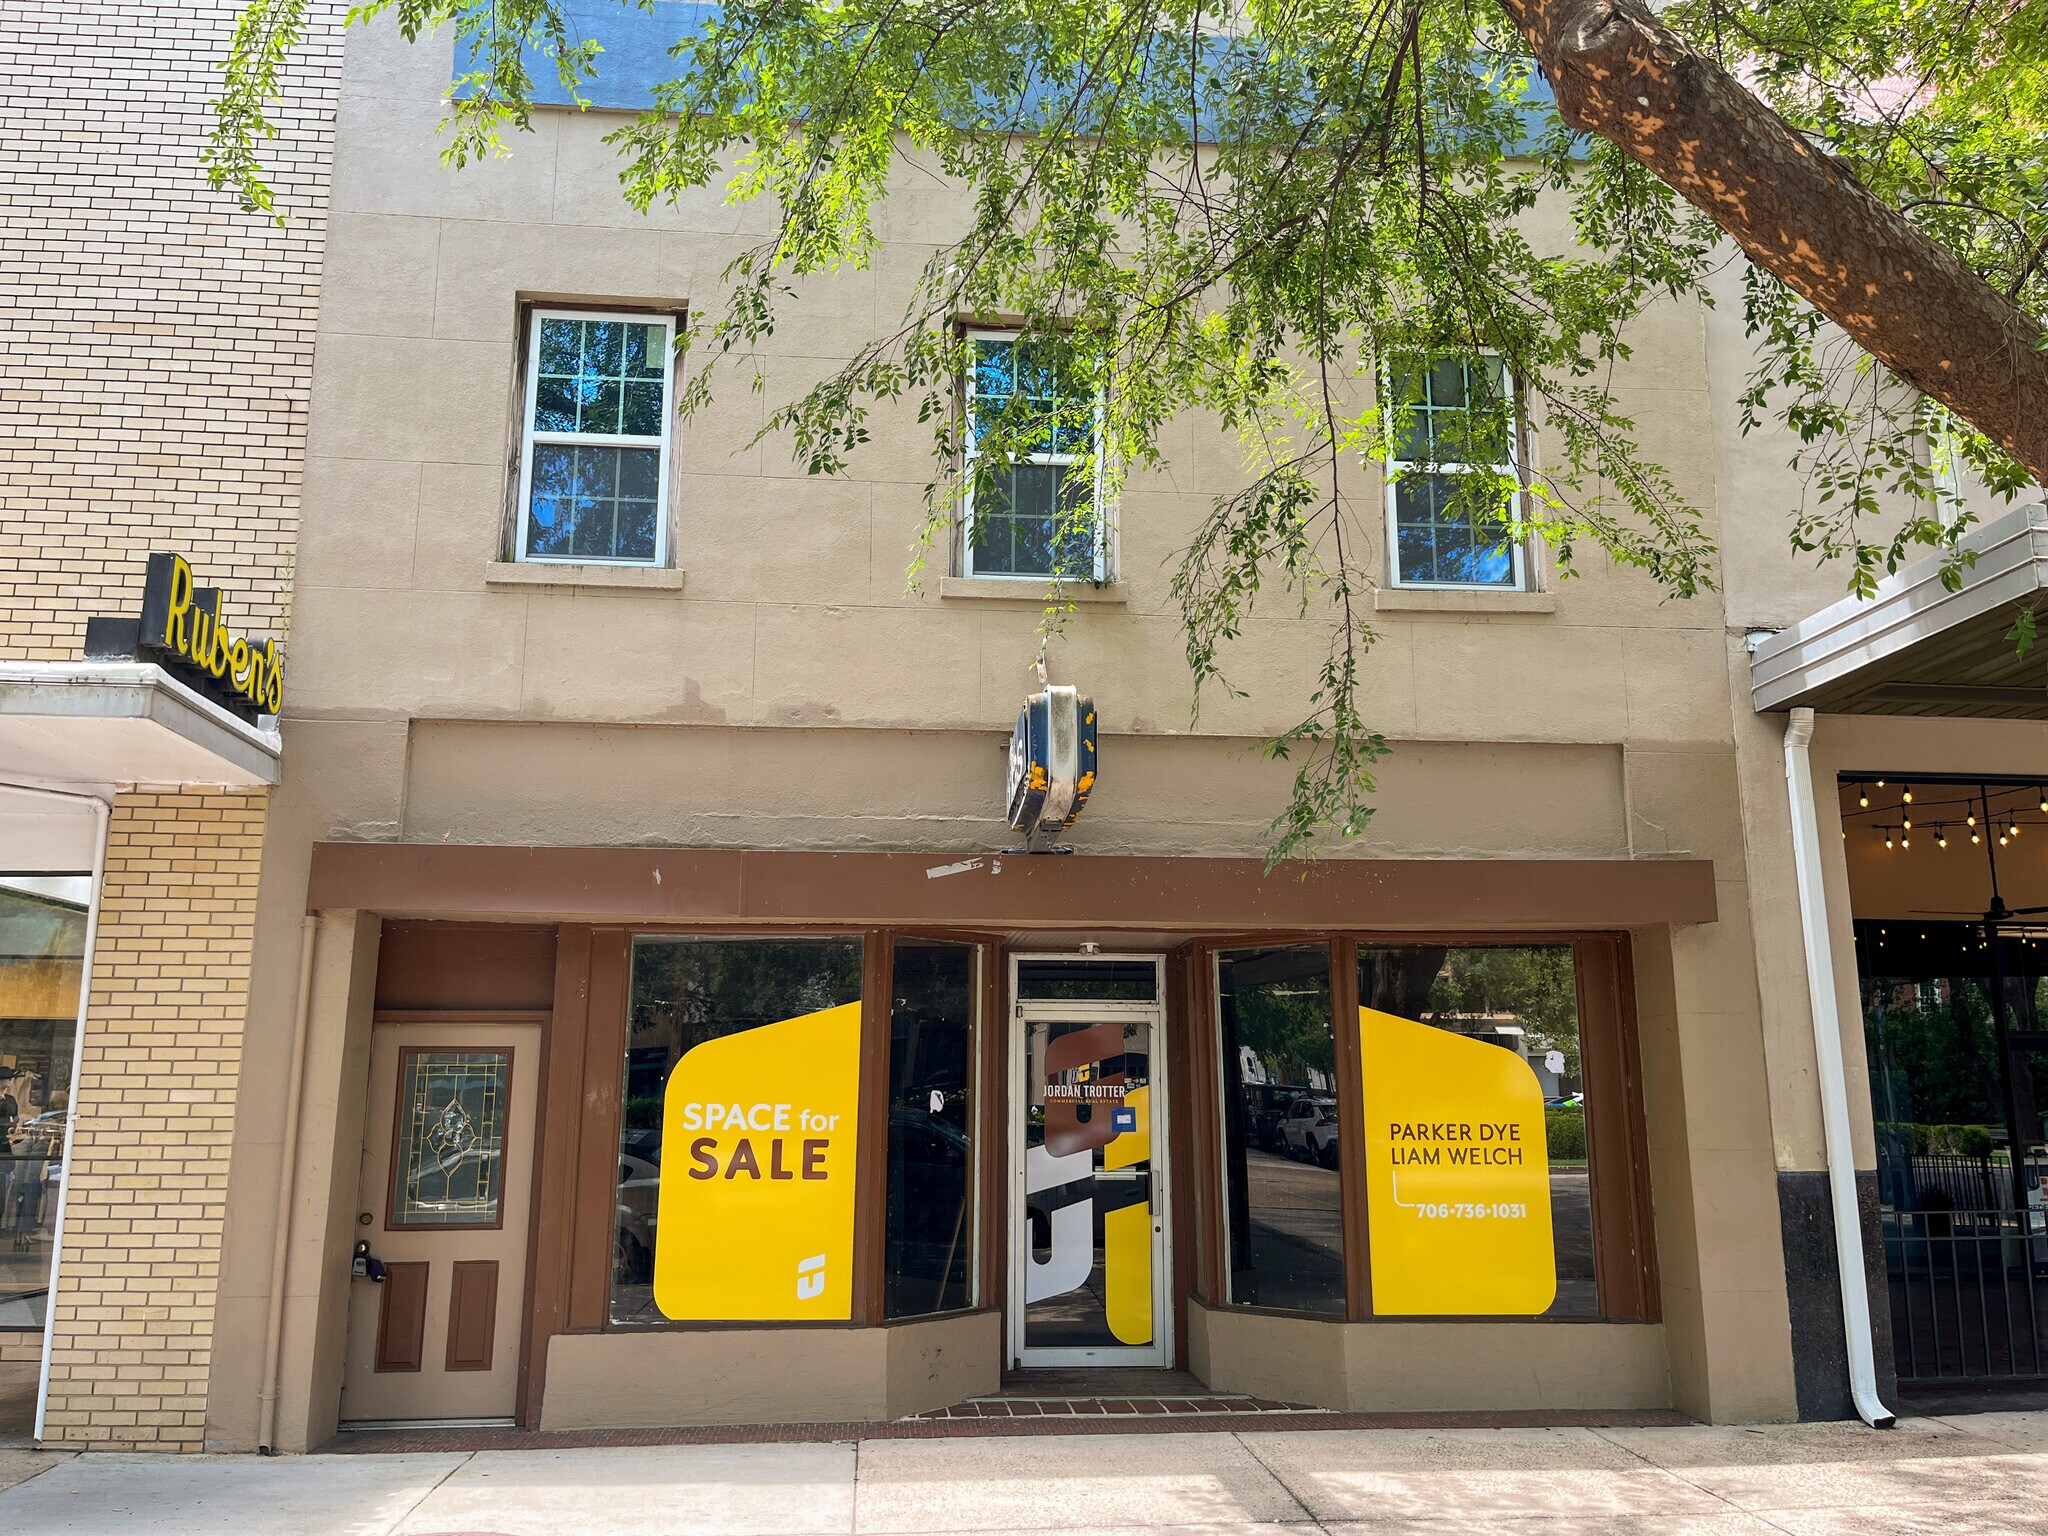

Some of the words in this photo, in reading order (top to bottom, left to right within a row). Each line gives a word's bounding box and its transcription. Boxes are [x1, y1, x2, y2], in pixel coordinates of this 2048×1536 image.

[165, 554, 283, 714] Ruben's
[1043, 1085, 1081, 1097] JORDAN
[1083, 1085, 1125, 1098] TROTTER
[683, 1102, 792, 1131] SPACE
[799, 1109, 840, 1131] for
[1390, 1123, 1473, 1141] PARKER
[1479, 1123, 1521, 1141] DYE
[688, 1137, 830, 1180] SALE
[1391, 1147, 1441, 1165] LIAM
[1447, 1147, 1523, 1165] WELCH
